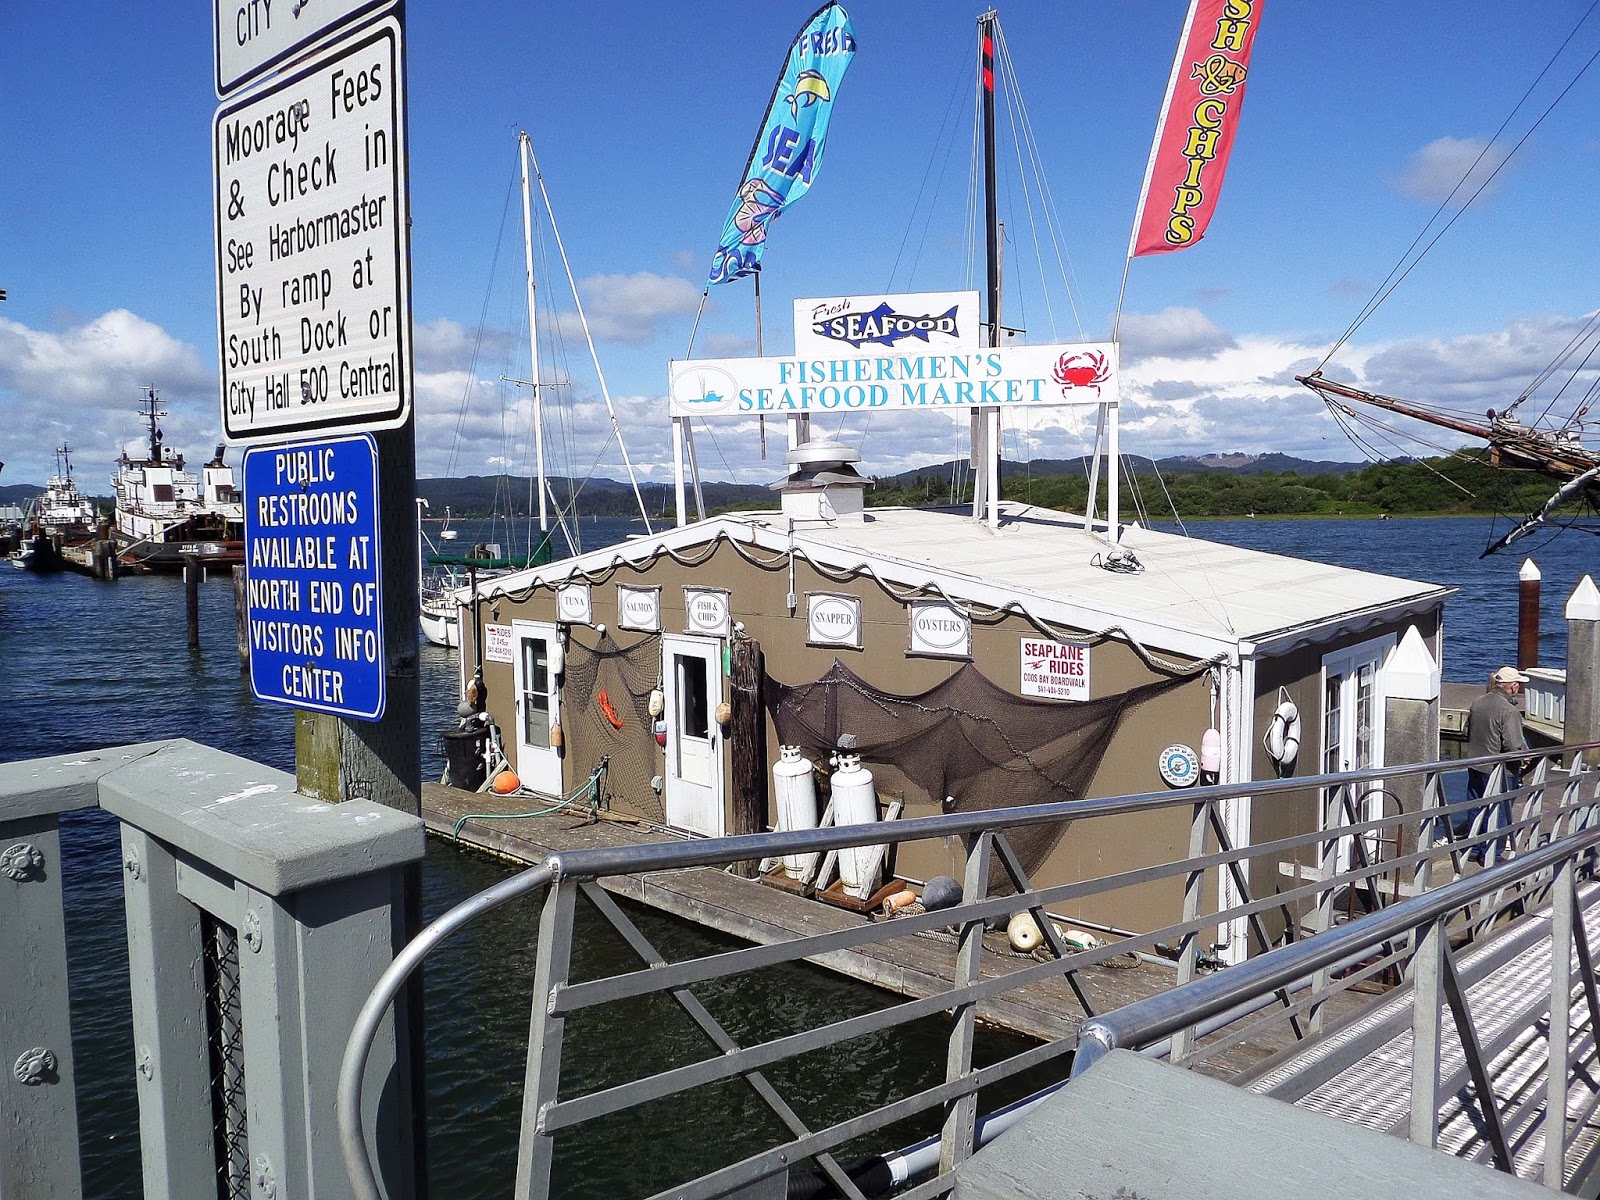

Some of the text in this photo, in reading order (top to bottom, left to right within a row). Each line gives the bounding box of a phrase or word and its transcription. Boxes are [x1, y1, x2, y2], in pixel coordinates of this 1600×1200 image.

[235, 0, 272, 47] CITY
[798, 26, 857, 58] FRESH
[1199, 53, 1236, 96] &
[226, 63, 382, 166] Moorage Fees
[227, 123, 387, 221] & Check in
[762, 124, 817, 187] SEA
[1165, 98, 1226, 244] CHIPS
[227, 193, 387, 274] See Harbormaster
[240, 247, 374, 326] By ramp at
[811, 298, 851, 320] Fresh
[229, 306, 391, 369] South Dock or
[830, 315, 956, 341] SEAFOOD
[778, 352, 1003, 385] FISHERMEN'S
[229, 352, 396, 424] City Hall 500 Central
[738, 378, 1047, 412] SEAFOOD MARKET
[275, 448, 335, 486] PUBLIC
[258, 490, 358, 527] RESTROOMS
[252, 535, 370, 570] AVAILABLE AT
[249, 578, 376, 617] NORTH END OF
[564, 596, 585, 606] TUNA
[626, 601, 653, 613] SALMON
[697, 601, 718, 611] FISH &
[496, 627, 511, 638] RIDES
[697, 611, 717, 622] CHIPS
[814, 611, 852, 625] SNAPPER
[918, 618, 962, 633] OYSTERS
[251, 619, 377, 664] VISITORS INFO
[1024, 642, 1084, 661] SEAPLANE
[282, 664, 344, 704] CENTER
[1023, 672, 1086, 689] COOS BAY BOARDWALK
[1049, 659, 1084, 677] RIDES
